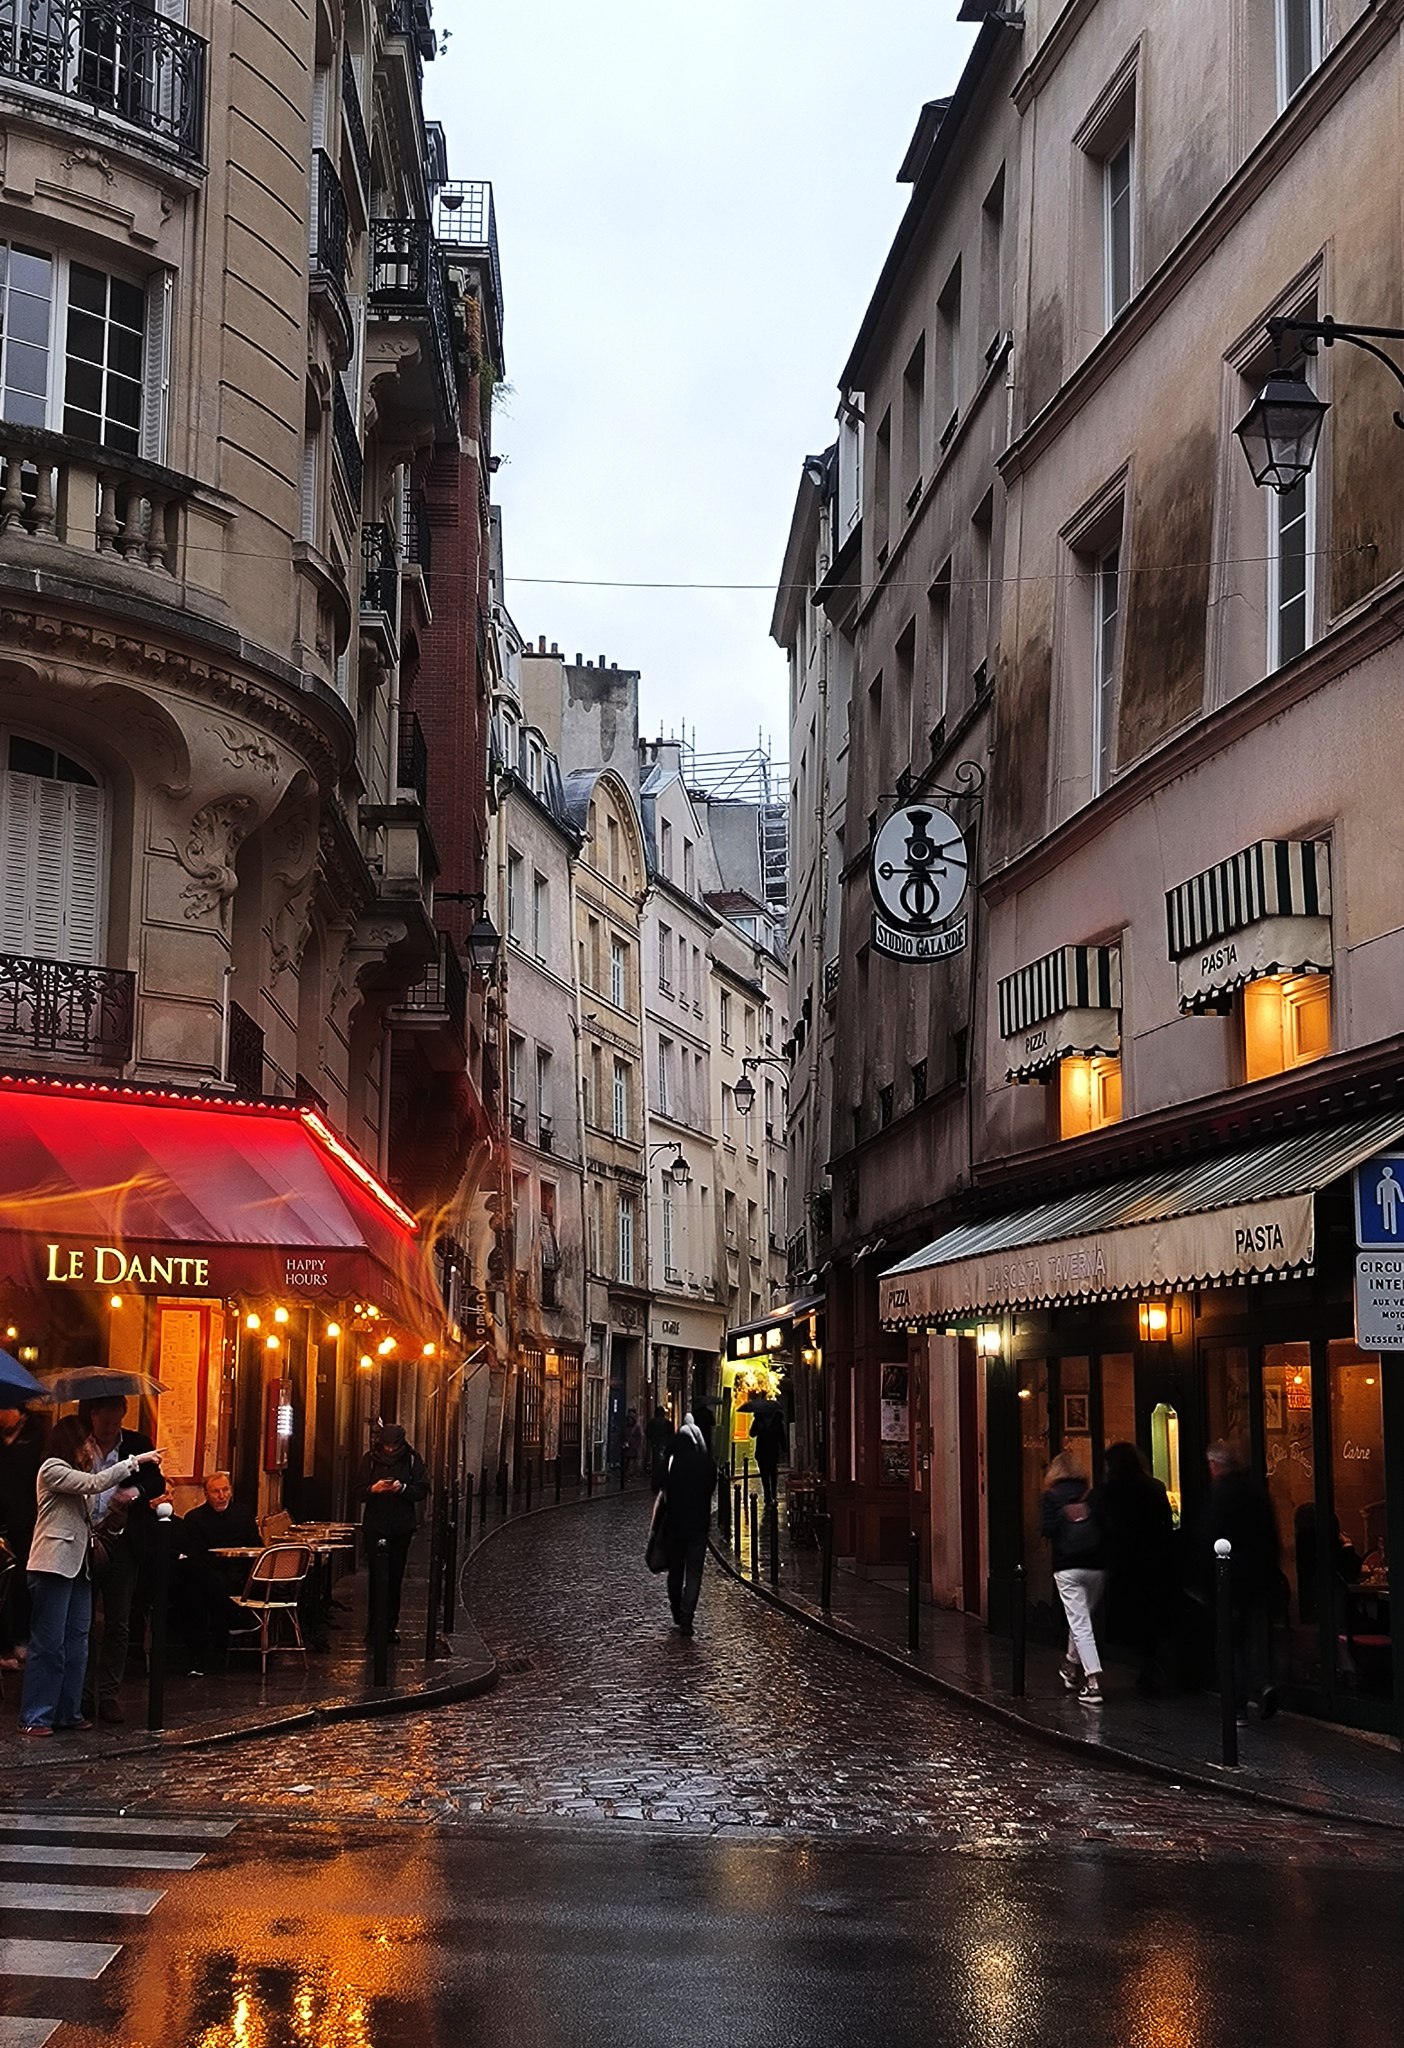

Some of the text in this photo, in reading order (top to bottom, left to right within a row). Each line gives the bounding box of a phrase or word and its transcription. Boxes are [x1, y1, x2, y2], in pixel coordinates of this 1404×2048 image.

[878, 925, 964, 956] STUDIO GALANDE
[1202, 944, 1237, 976] PASTA
[1026, 1031, 1047, 1054] PIZZA
[1235, 1224, 1284, 1254] PASTA
[286, 1259, 326, 1271] HAPPY
[1361, 1262, 1402, 1273] CIRCU
[285, 1273, 328, 1286] HOURS
[1370, 1279, 1404, 1290] INTE
[888, 1289, 910, 1308] PIZZA
[1343, 1440, 1371, 1460] Carne
